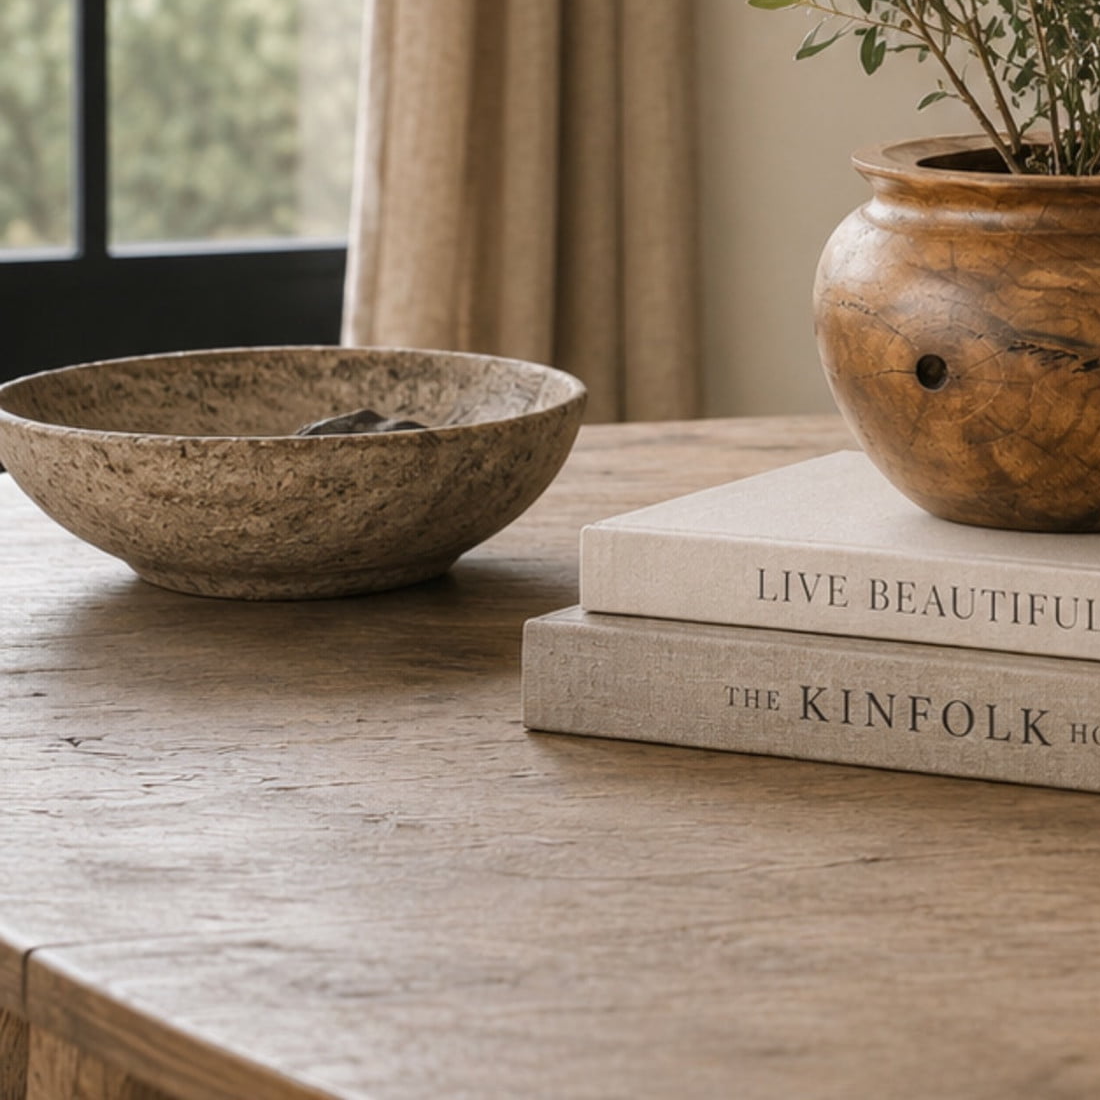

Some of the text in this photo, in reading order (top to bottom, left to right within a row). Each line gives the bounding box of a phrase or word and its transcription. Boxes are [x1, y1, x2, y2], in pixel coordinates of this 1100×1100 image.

[757, 568, 849, 607] LIVE
[724, 685, 781, 711] THE
[800, 685, 1052, 746] KINFOLK
